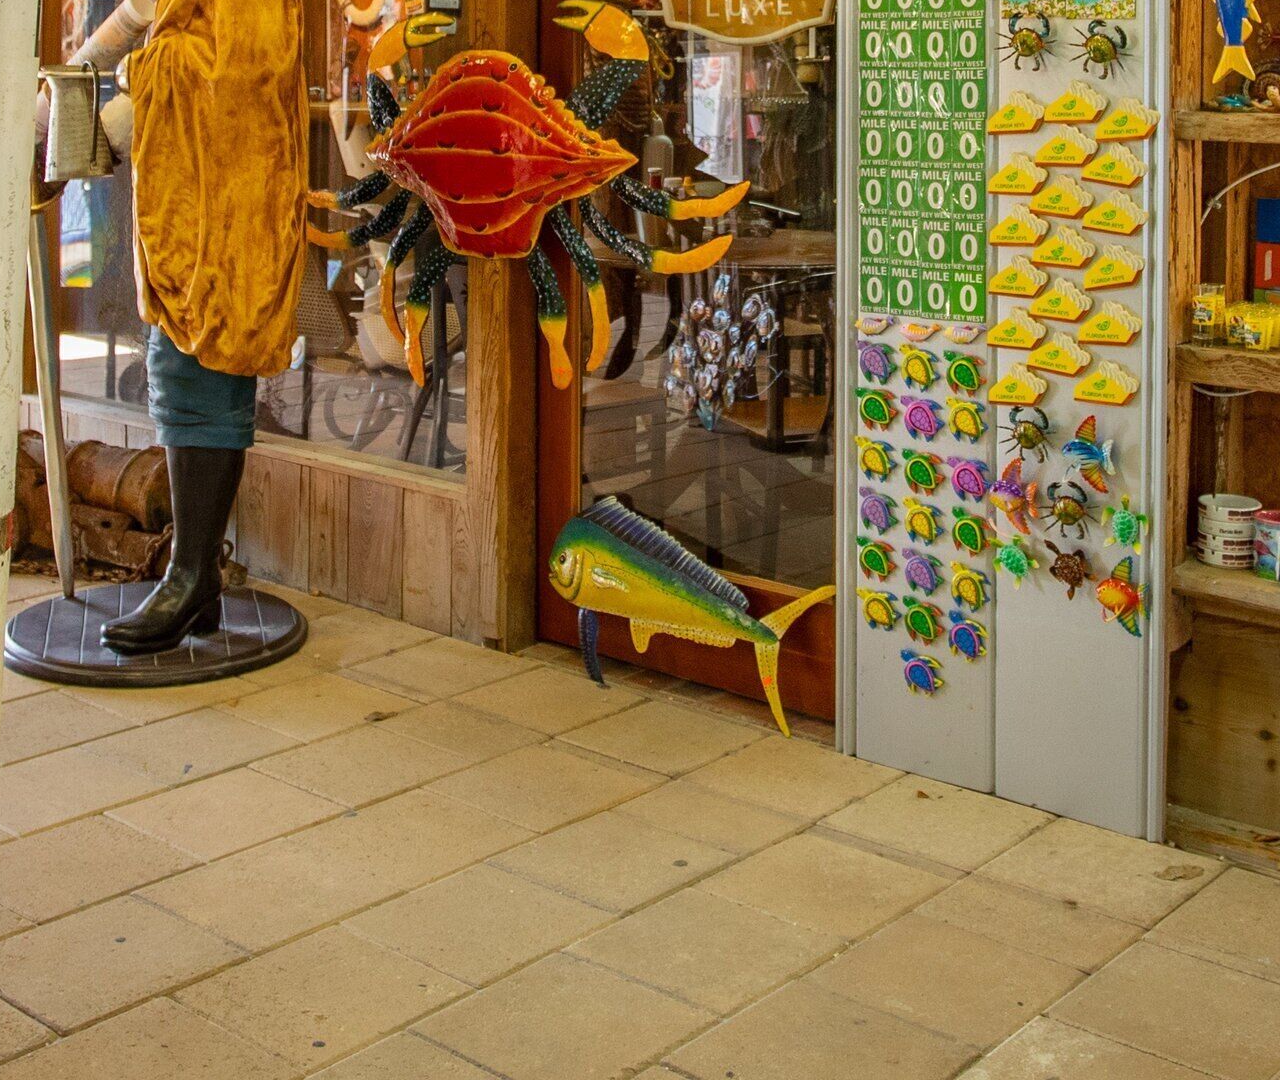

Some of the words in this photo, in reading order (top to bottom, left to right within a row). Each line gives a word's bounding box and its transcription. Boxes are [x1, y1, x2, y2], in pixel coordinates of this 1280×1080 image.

[861, 21, 886, 29] MILE
[891, 21, 917, 30] MILE
[922, 21, 949, 29] MILE
[954, 20, 982, 29] MILE
[866, 32, 882, 58] 0
[896, 32, 912, 58] 0
[927, 32, 944, 58] 0
[960, 31, 977, 58] 0
[862, 71, 887, 79] MILE
[892, 71, 918, 79] MILE
[923, 71, 950, 80] MILE
[956, 70, 983, 79] MILE
[866, 81, 882, 107] 0
[897, 82, 913, 108] 0
[928, 82, 945, 109] 0
[961, 82, 979, 109] 0
[861, 120, 886, 128] MILE
[892, 120, 917, 129] MILE
[922, 121, 949, 130] MILE
[954, 121, 981, 130] MILE
[866, 130, 882, 156] 0
[896, 131, 912, 158] 0
[927, 132, 944, 159] 0
[959, 132, 977, 160] 0
[861, 168, 886, 177] MILE
[891, 170, 917, 179] MILE
[922, 171, 949, 180] MILE
[954, 172, 981, 181] MILE
[866, 180, 881, 205] 0
[897, 181, 912, 207] 0
[928, 182, 944, 209] 0
[960, 183, 977, 210] 0
[862, 217, 887, 226] MILE
[892, 219, 918, 228] MILE
[923, 222, 950, 231] MILE
[955, 222, 983, 232] MILE
[867, 228, 883, 254] 0
[897, 230, 913, 257] 0
[928, 233, 945, 260] 0
[960, 234, 978, 261] 0
[862, 267, 887, 275] MILE
[892, 268, 918, 278] MILE
[923, 272, 949, 281] MILE
[955, 273, 982, 283] MILE
[1264, 250, 1273, 281] I
[867, 277, 882, 303] 0
[897, 280, 913, 306] 0
[928, 283, 944, 310] 0
[960, 285, 977, 312] 0
